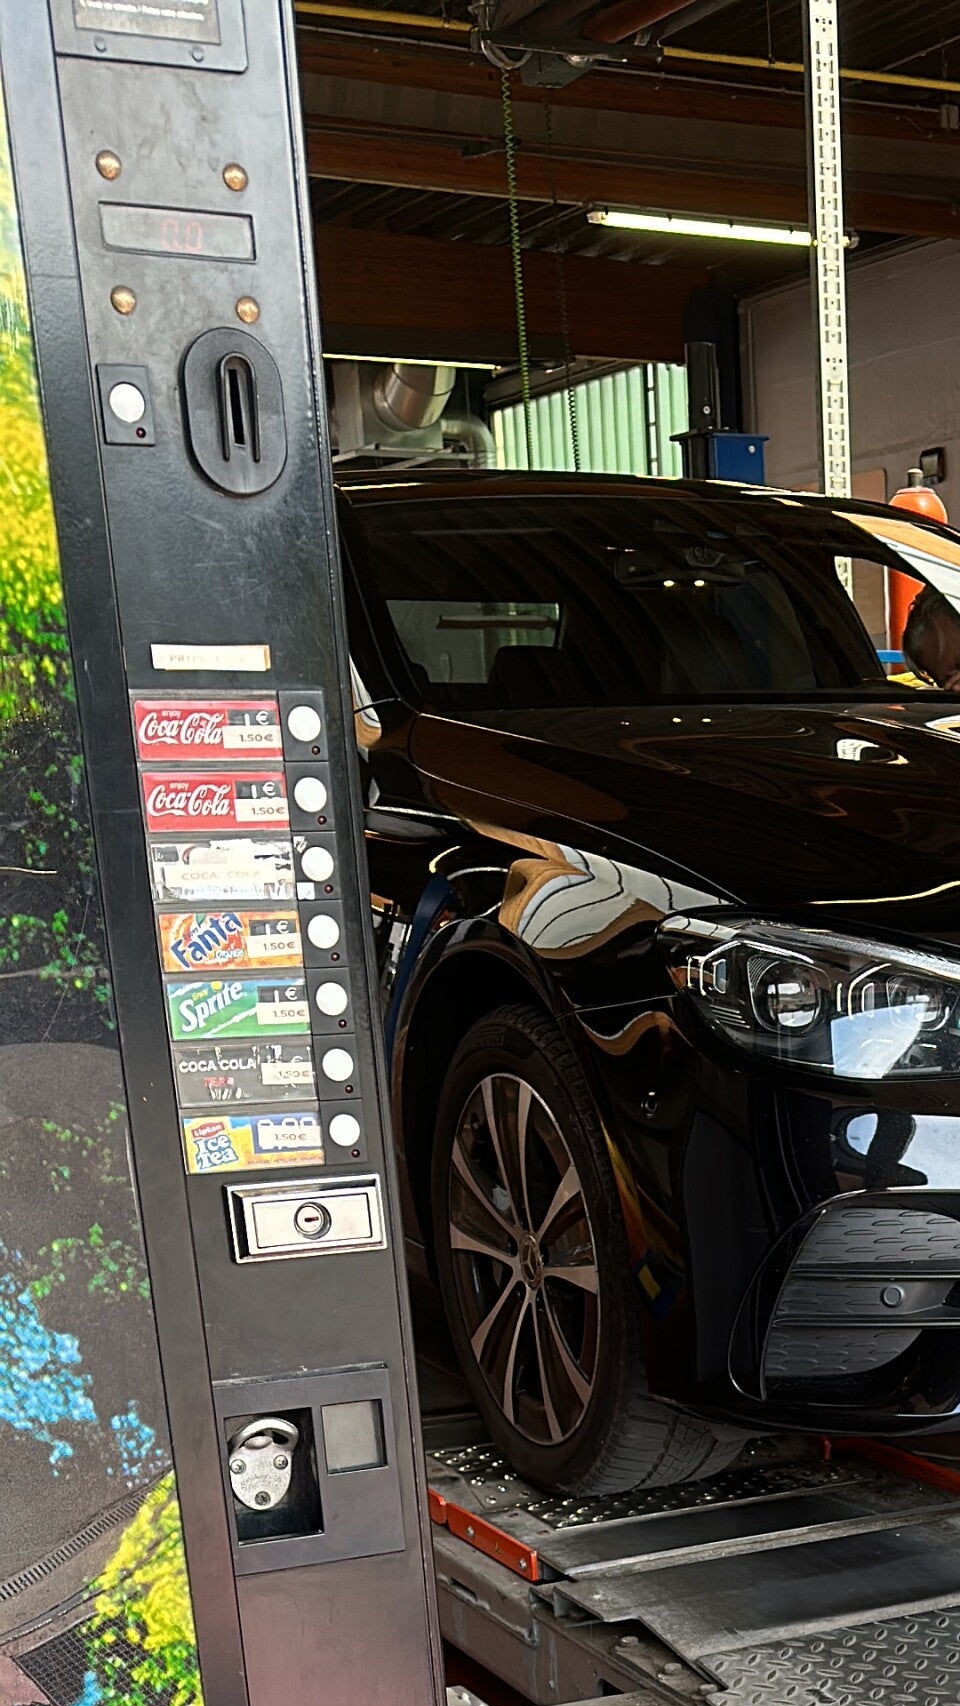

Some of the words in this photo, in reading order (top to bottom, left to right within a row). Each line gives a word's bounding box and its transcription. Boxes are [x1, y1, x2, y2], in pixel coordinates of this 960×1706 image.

[170, 912, 243, 968] Fanta
[180, 981, 243, 1033] Sprite
[179, 1060, 218, 1073] COCA
[219, 1058, 258, 1070] COLA
